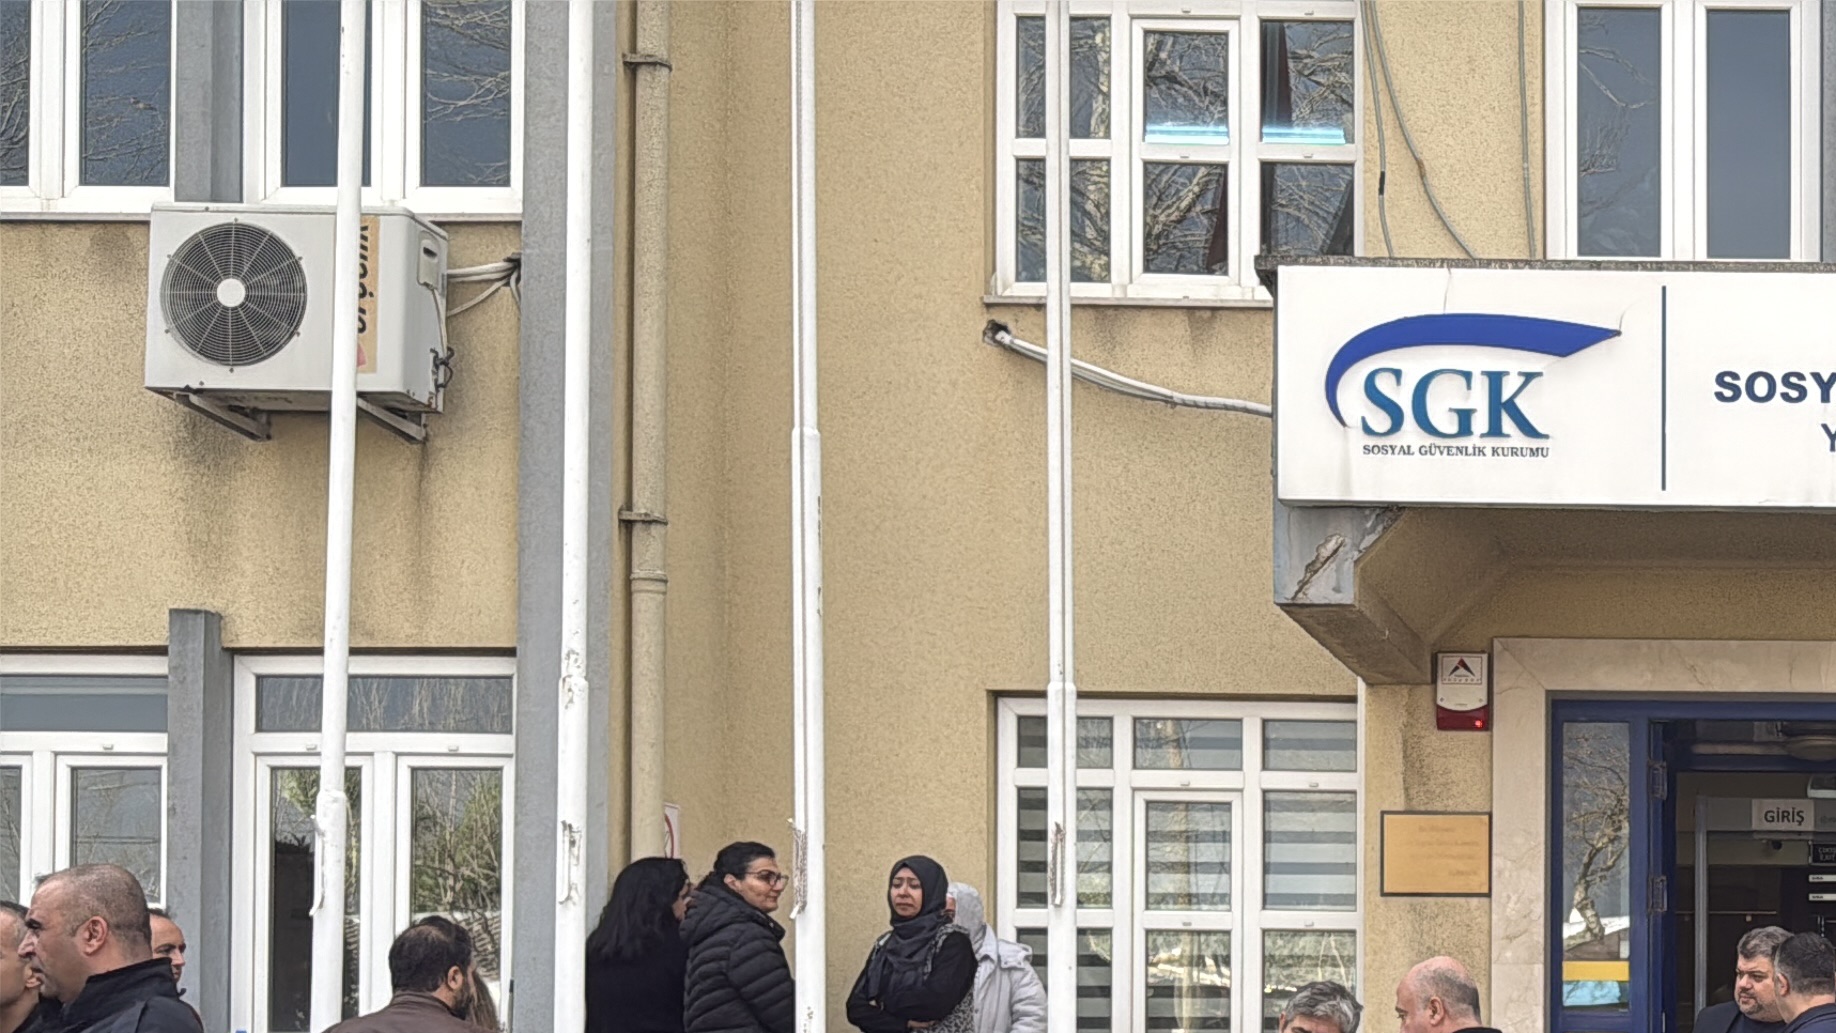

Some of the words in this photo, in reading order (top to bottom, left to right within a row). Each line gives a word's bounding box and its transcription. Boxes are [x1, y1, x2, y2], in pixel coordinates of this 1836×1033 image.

[1361, 368, 1550, 439] SGK
[1363, 445, 1414, 456] SOSYAL
[1419, 443, 1487, 457] GÜVENLİK
[1491, 446, 1549, 458] KURUMU
[1764, 807, 1805, 826] GİRİŞ
